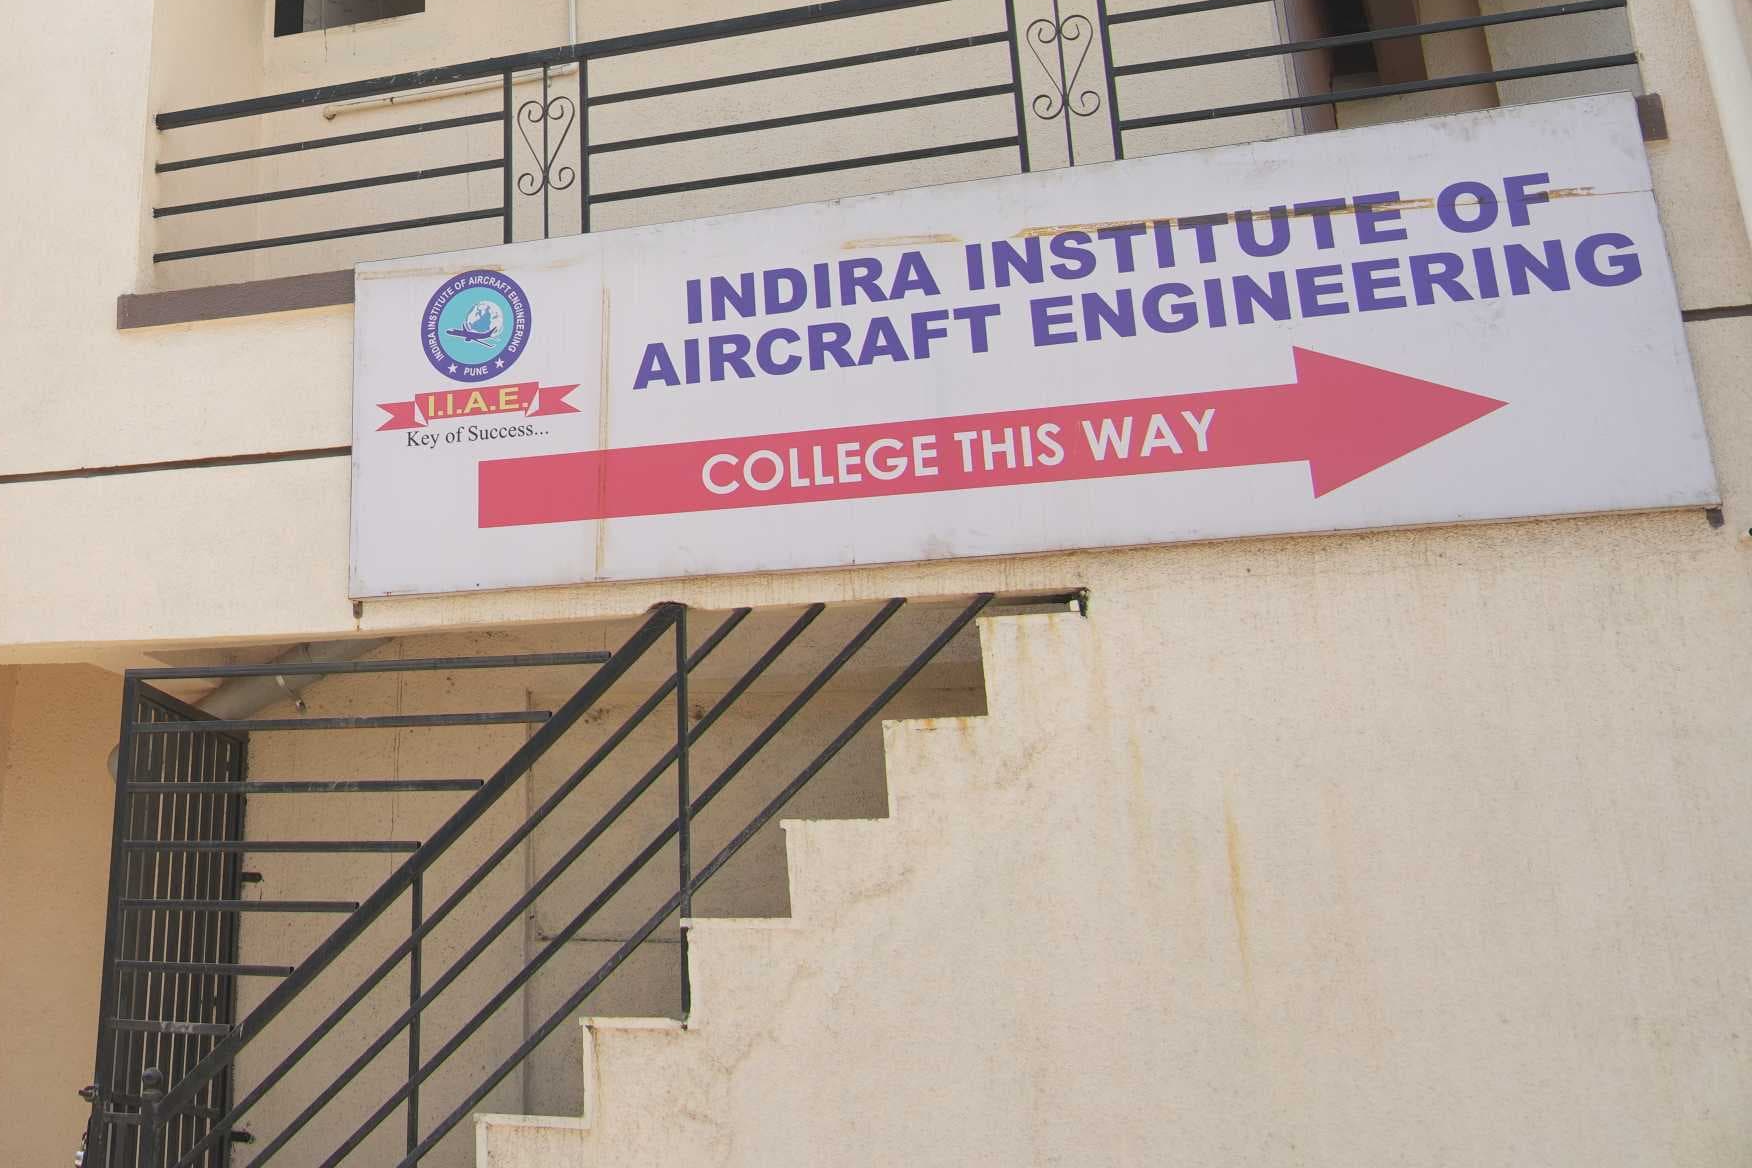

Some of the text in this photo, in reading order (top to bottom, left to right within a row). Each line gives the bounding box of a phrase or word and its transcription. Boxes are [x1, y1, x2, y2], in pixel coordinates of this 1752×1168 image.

[686, 172, 1550, 324] INDIRA INSTITUTE OF
[427, 275, 526, 361] INDIRA INSTITUTE OF AIRCRAFT ENGINEERING
[633, 232, 1643, 390] AIRCRAFT ENGINEERING
[428, 386, 529, 417] I.I.A.E.
[463, 365, 489, 377] PUNE
[406, 430, 440, 449] Key
[445, 426, 465, 444] of
[701, 408, 1216, 495] COLLEGE THIS WAY
